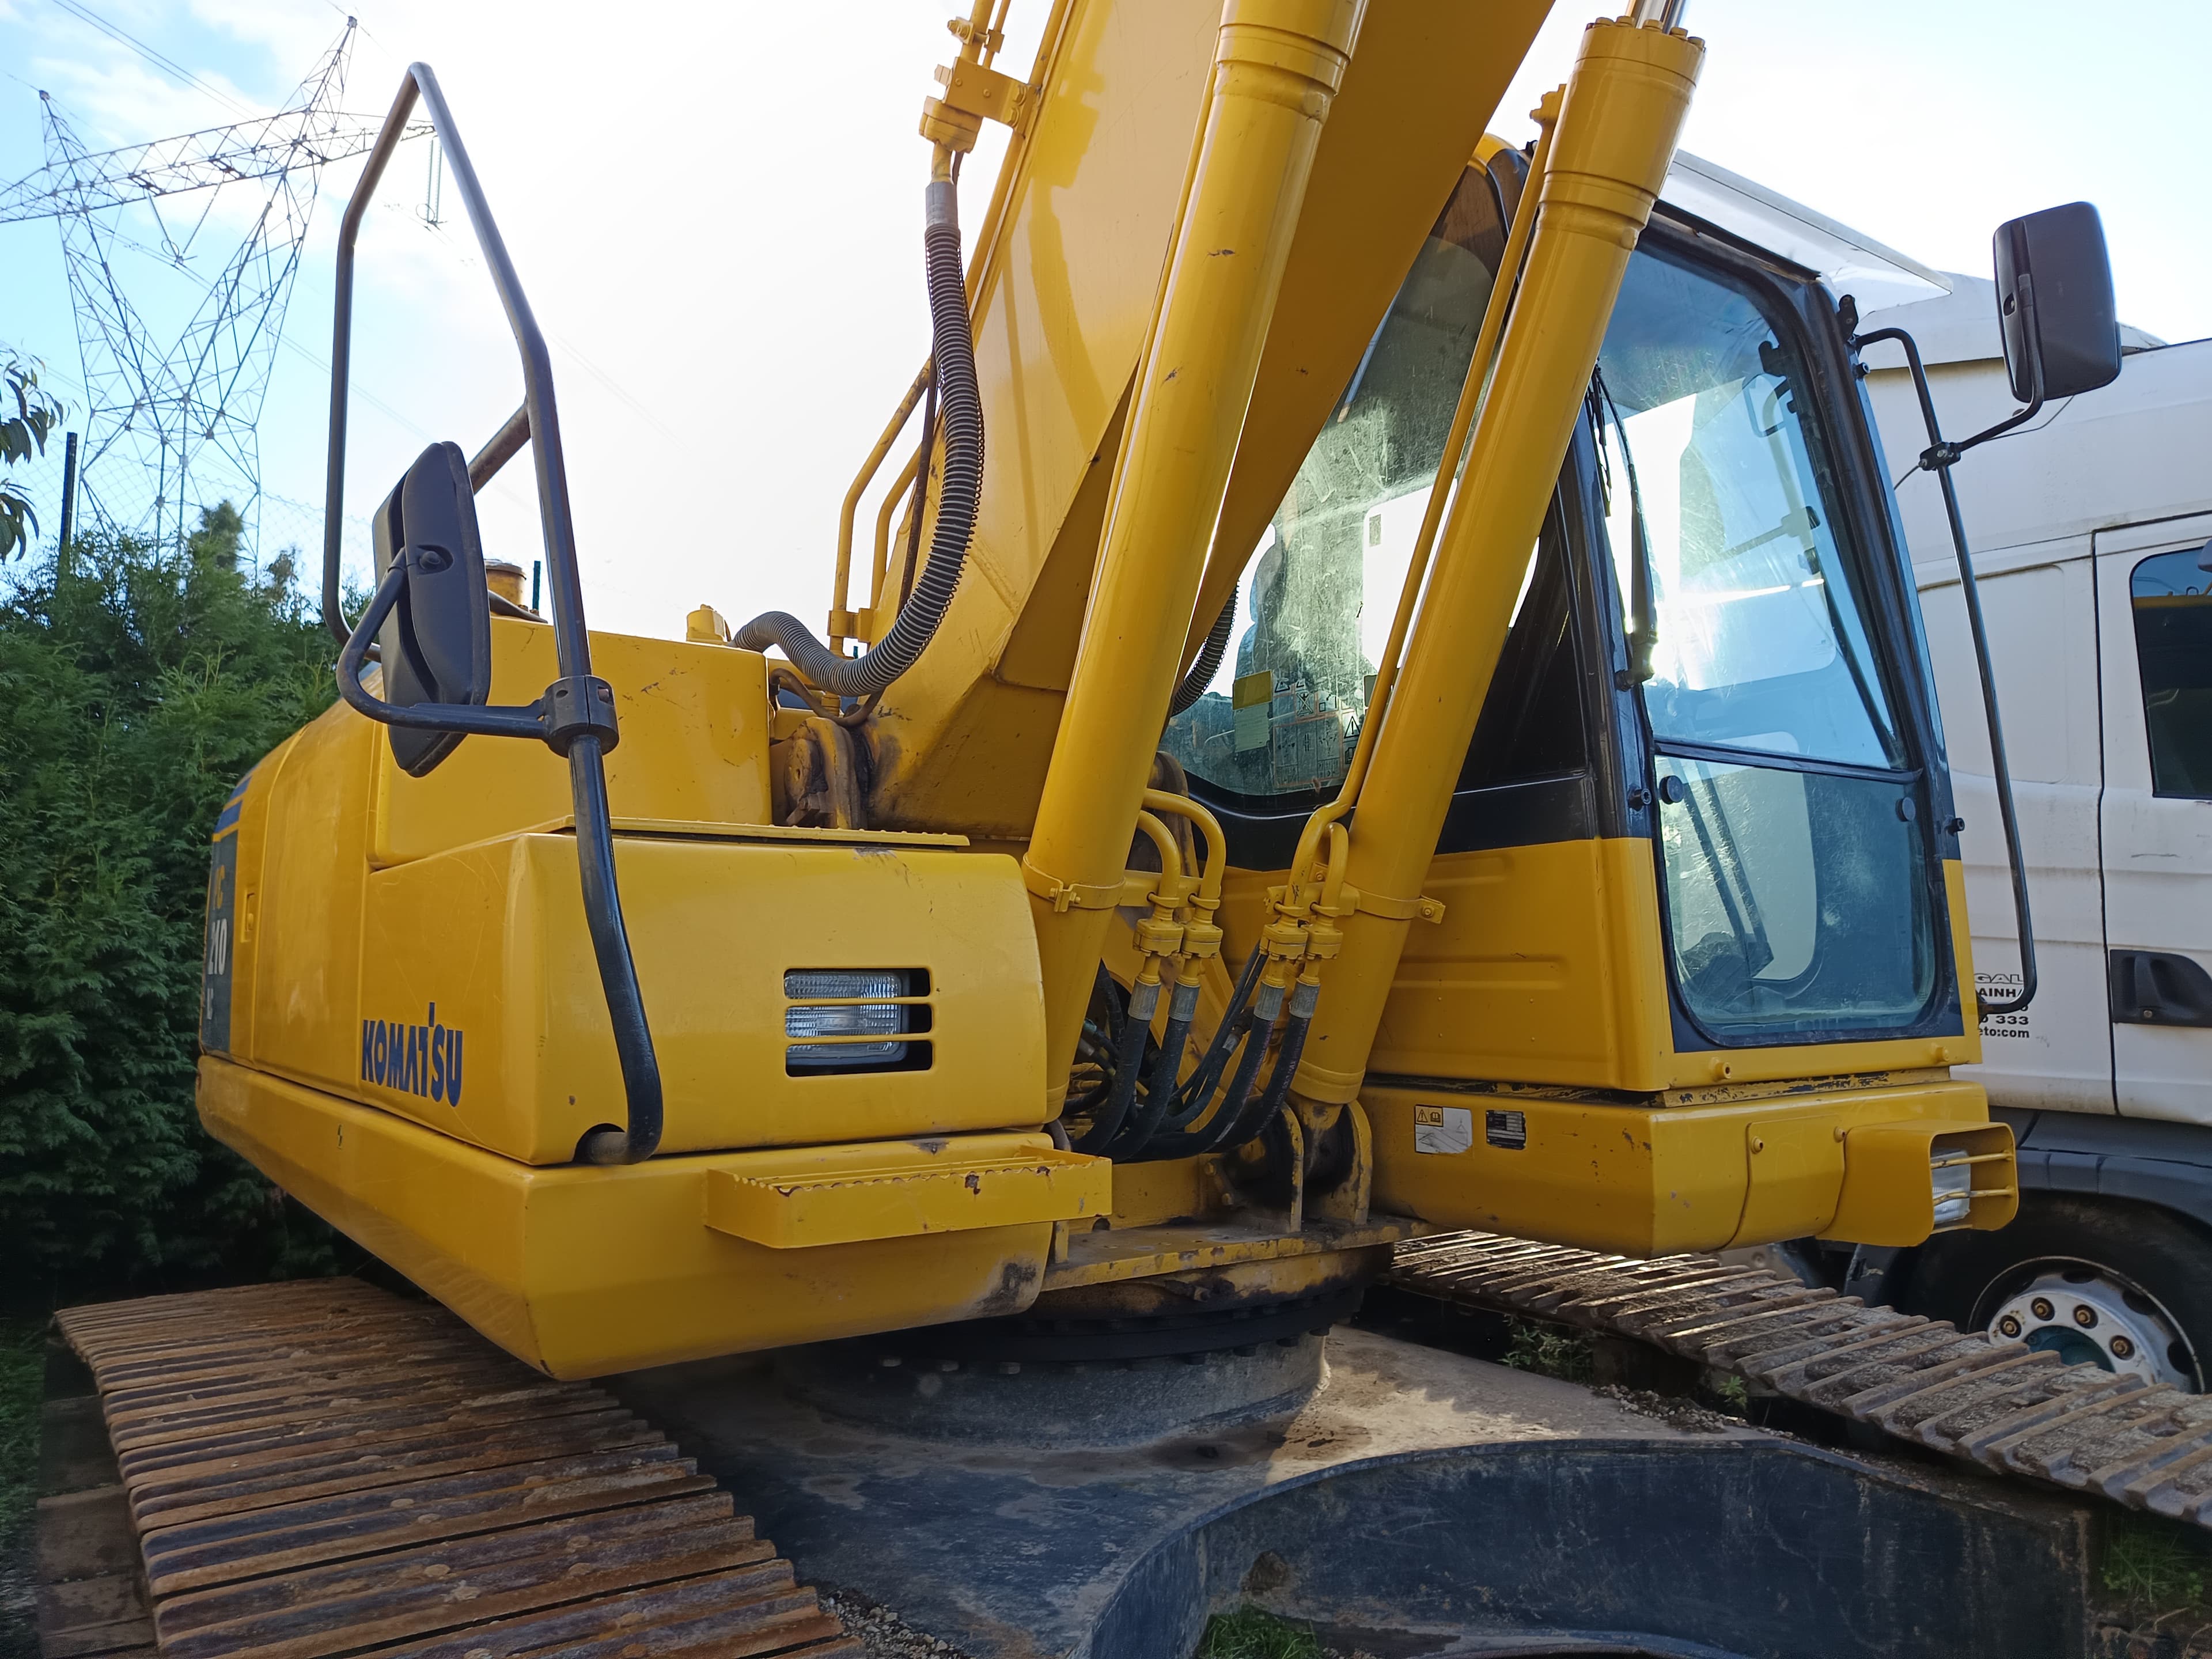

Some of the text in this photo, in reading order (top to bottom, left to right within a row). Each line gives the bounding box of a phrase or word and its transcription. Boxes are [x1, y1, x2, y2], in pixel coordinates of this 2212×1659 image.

[1978, 987, 2022, 998] AINH
[1995, 1015, 2029, 1025] 333
[361, 1001, 463, 1107] KOMATSU
